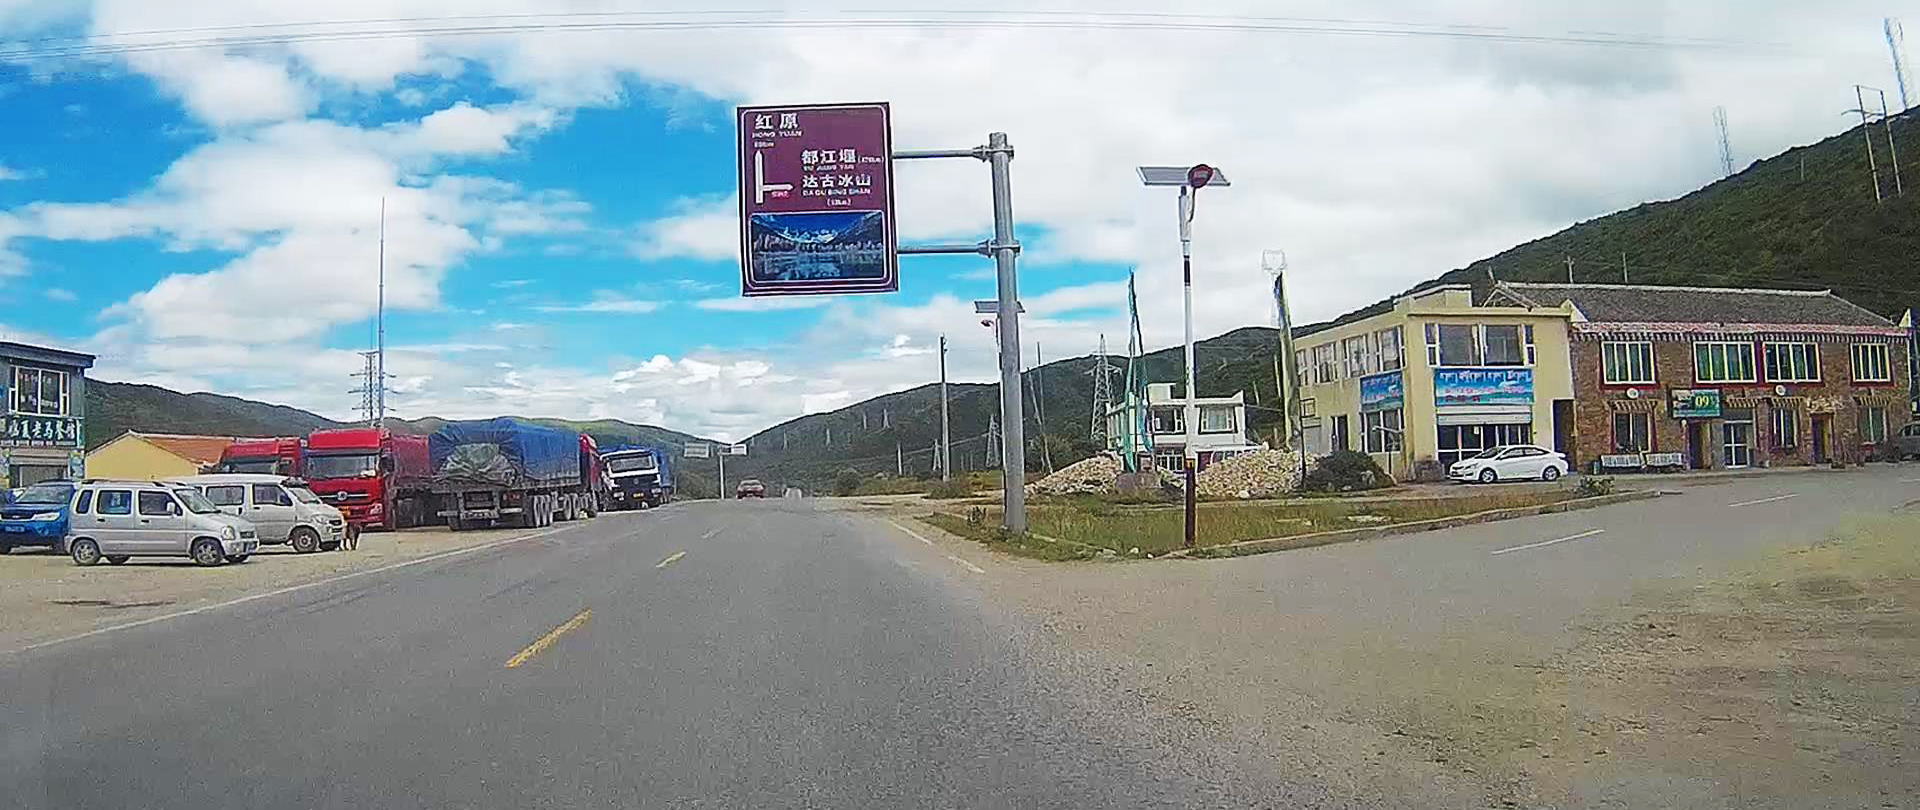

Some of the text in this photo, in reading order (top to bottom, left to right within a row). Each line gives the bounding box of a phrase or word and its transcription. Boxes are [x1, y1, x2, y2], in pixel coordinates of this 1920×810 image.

[755, 113, 798, 129] 红原
[802, 149, 856, 164] 都江堰
[802, 174, 871, 188] 达古冰山
